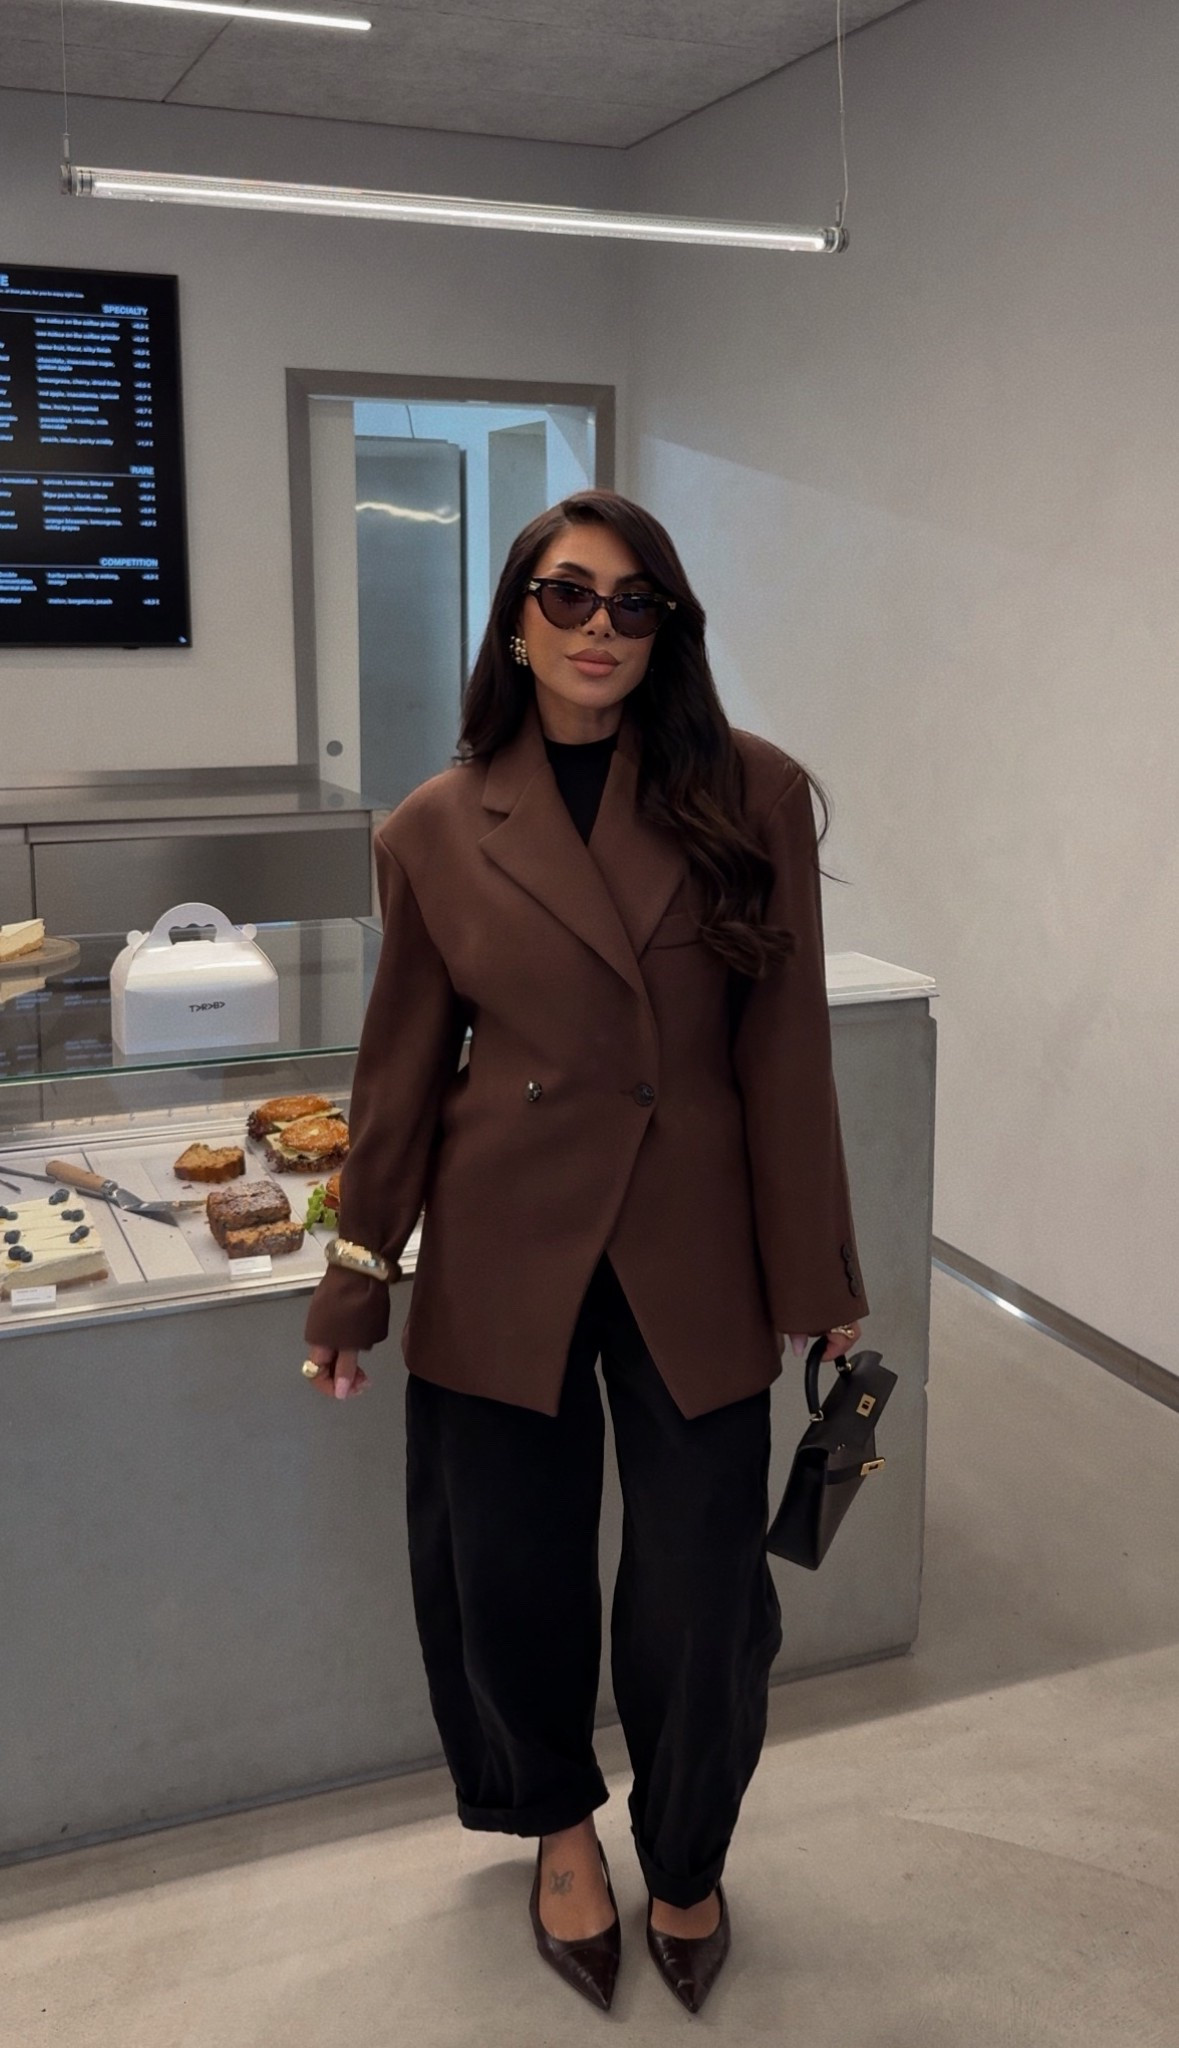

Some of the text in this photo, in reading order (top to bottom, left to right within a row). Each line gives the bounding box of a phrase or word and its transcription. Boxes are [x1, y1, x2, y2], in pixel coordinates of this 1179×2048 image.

[102, 304, 148, 316] SPECIALTY
[131, 466, 154, 475] RARE
[100, 558, 158, 567] COMPETITION
